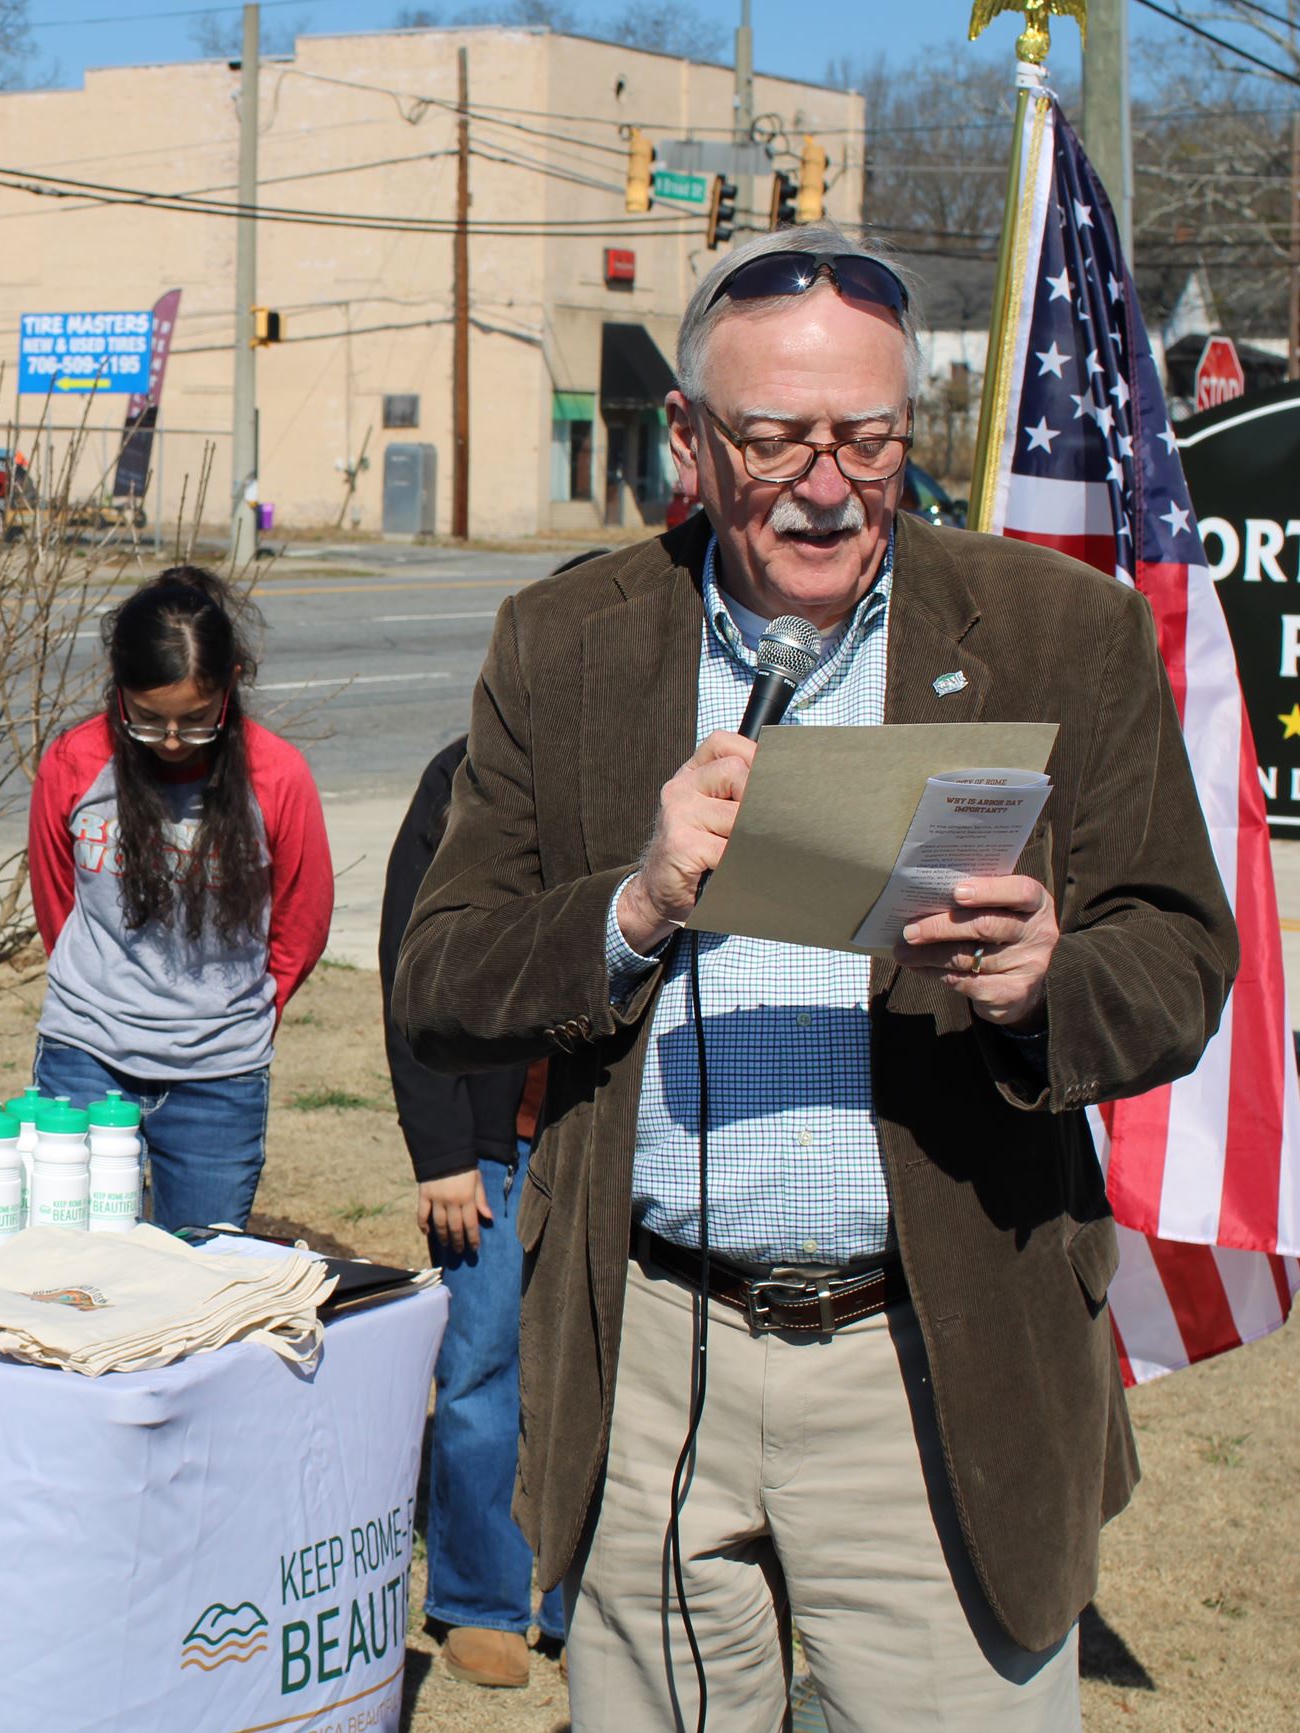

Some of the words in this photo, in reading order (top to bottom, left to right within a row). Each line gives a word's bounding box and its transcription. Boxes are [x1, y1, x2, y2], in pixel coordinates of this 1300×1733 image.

[23, 315, 63, 335] TIRE
[66, 313, 149, 335] MASTERS
[1201, 376, 1240, 409] STOP
[281, 1535, 344, 1605] KEEP
[351, 1498, 414, 1578] ROME-F
[281, 1564, 410, 1696] BEAUTI
